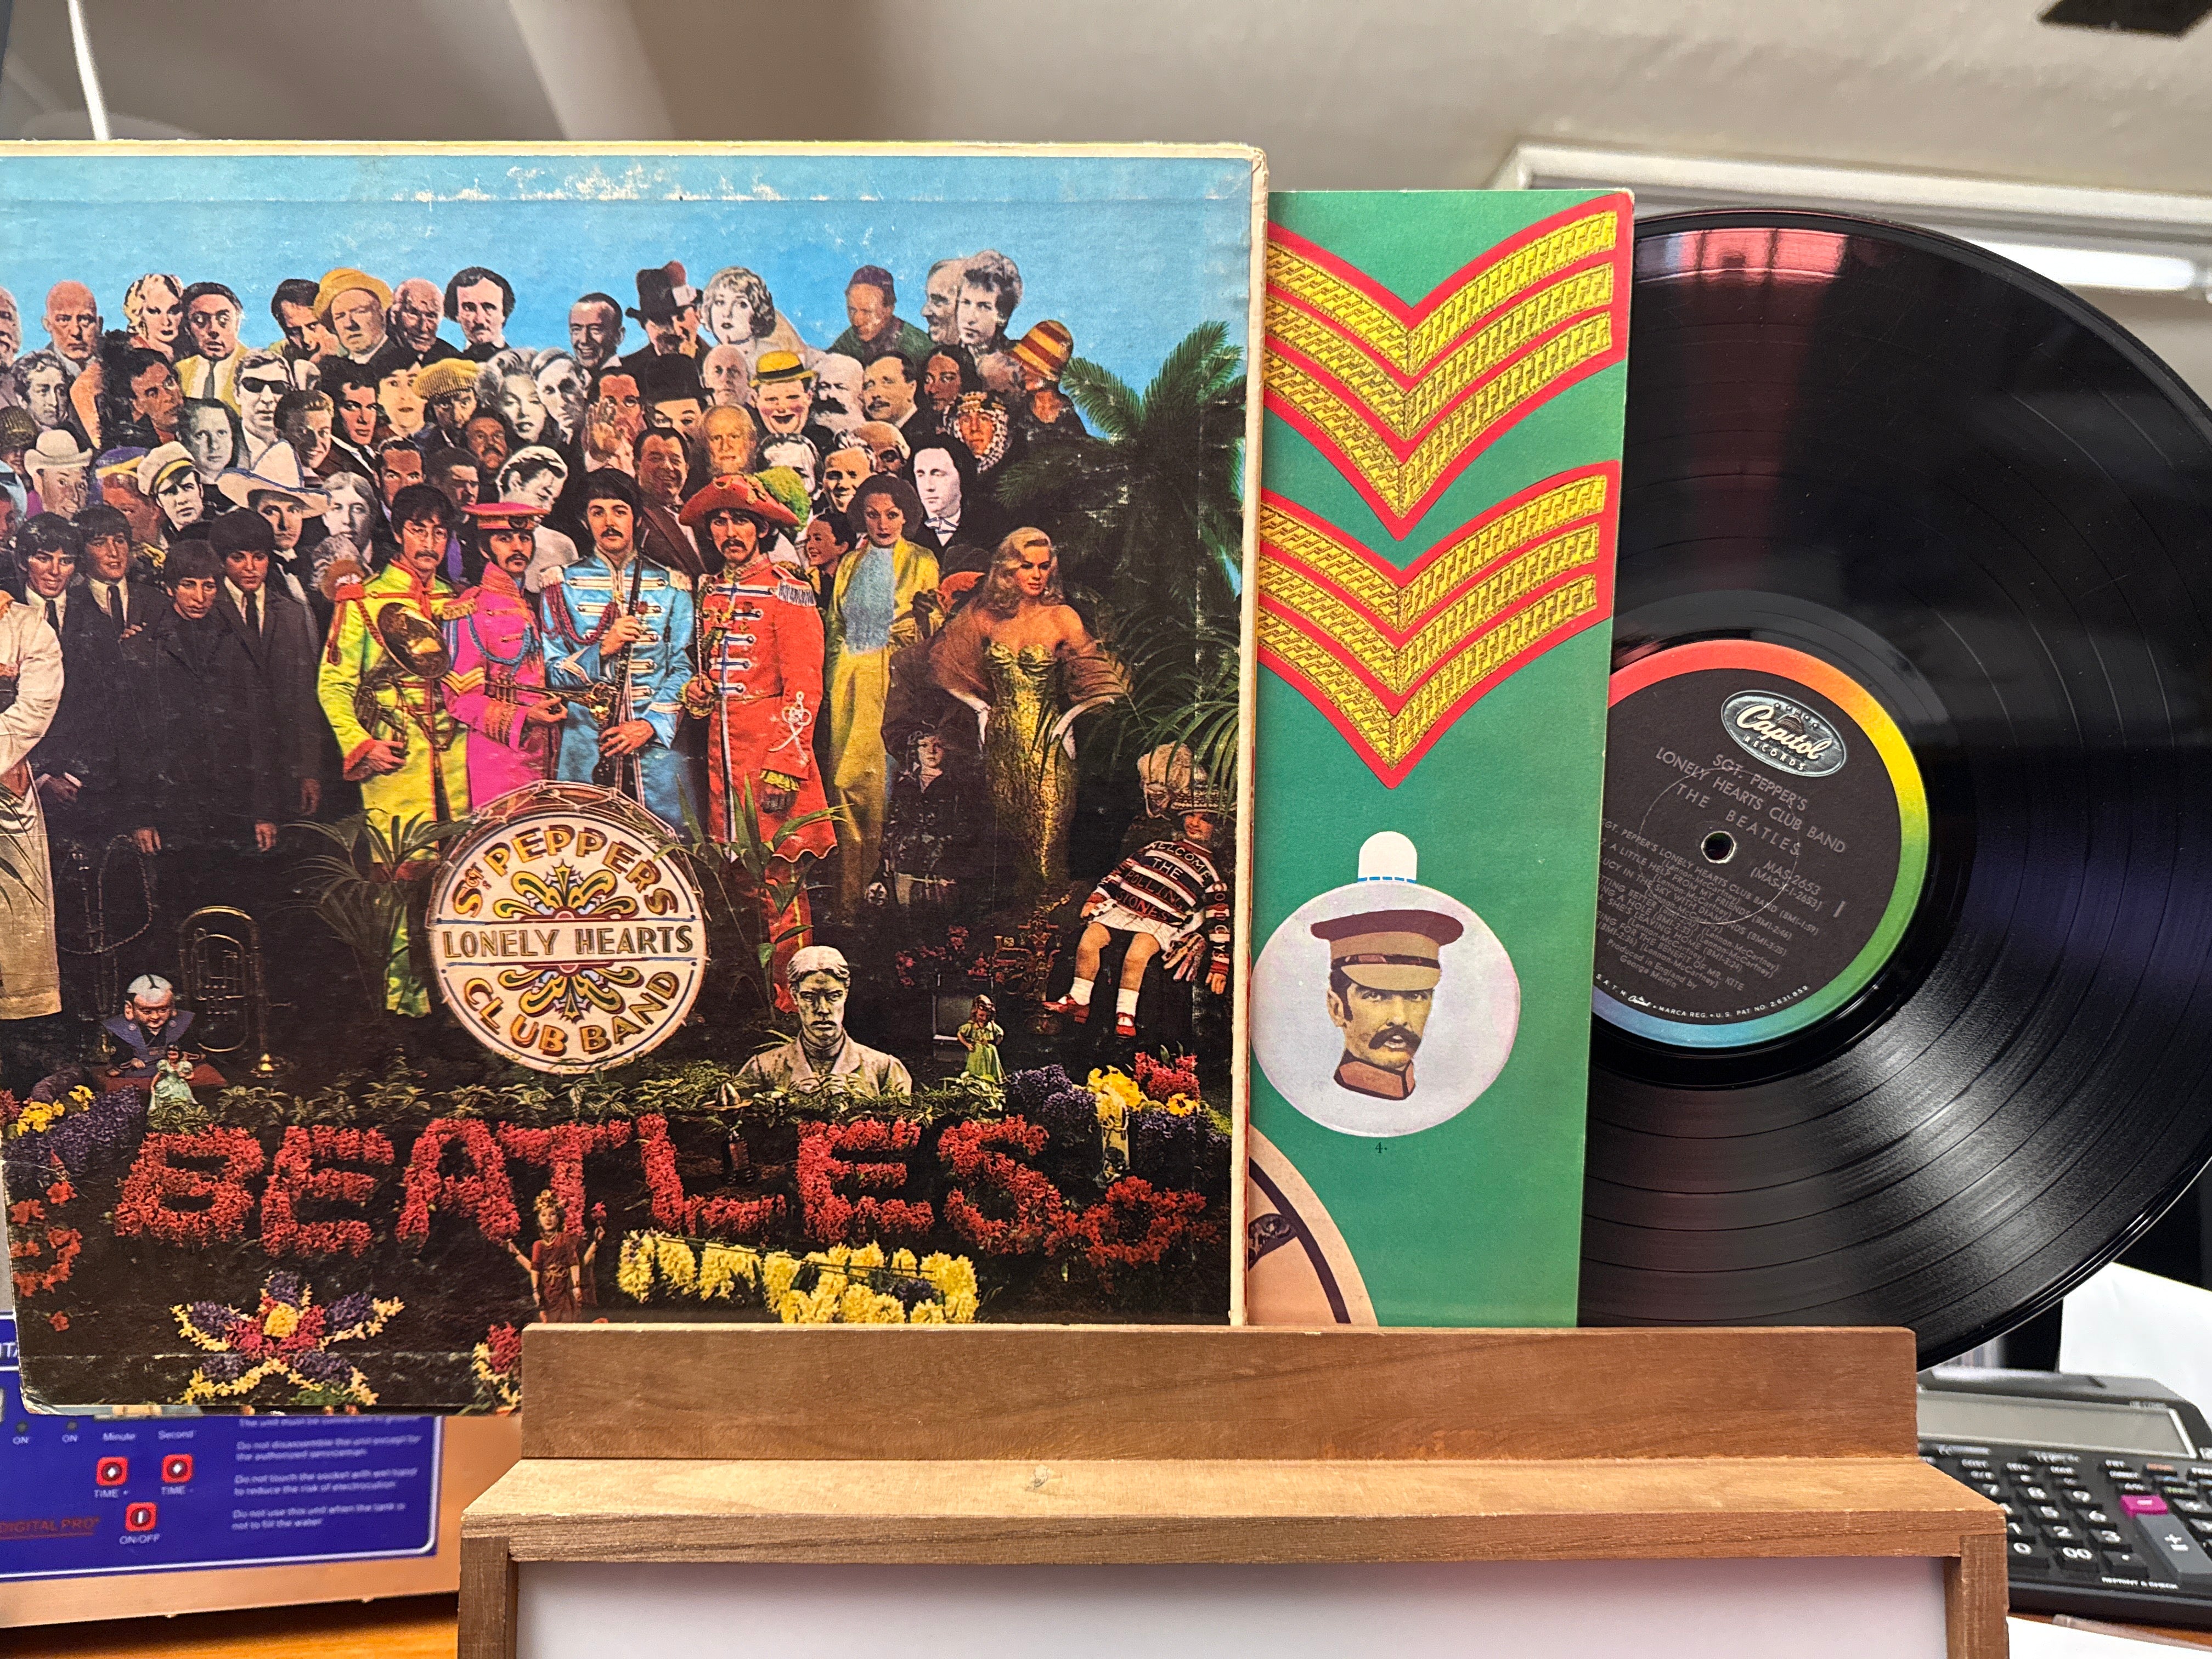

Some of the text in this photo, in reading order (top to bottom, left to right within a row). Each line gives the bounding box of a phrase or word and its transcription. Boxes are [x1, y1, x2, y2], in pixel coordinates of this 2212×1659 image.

[1736, 704, 1832, 760] Capitol
[1743, 736, 1805, 771] RECORDS
[1655, 746, 1847, 855] LONELY HEARTS CLUB BAND
[1711, 752, 1809, 812] SGT. PEPPER'S
[1674, 782, 1802, 856] THE BEATLES
[483, 824, 680, 916] PEPPERS
[1152, 858, 1183, 880] THE
[1609, 842, 1618, 851] A
[1619, 847, 1647, 866] LITTLE
[1647, 861, 1671, 878] HELP
[1671, 873, 1697, 891] FROM
[1699, 888, 1714, 900] MY
[1714, 895, 1751, 919] FRIENDS
[1621, 828, 1658, 853] PEPPER'S
[1658, 848, 1693, 870] LONELY
[1694, 866, 1728, 888] HEARTS
[1728, 883, 1752, 900] CLUB
[1752, 895, 1778, 913] BAND
[1660, 859, 1741, 906] (Lennon-McCartney)
[1115, 891, 1170, 921] STONES
[1598, 855, 1622, 872] UCY
[1622, 867, 1634, 878] IN
[1635, 874, 1654, 889] THE
[1654, 883, 1672, 898] SKY
[1672, 893, 1696, 910] WITH
[1697, 906, 1746, 935] DIAMONDS
[1651, 873, 1733, 920] (Lennon-McCartney)
[443, 926, 693, 958] LONELY HEARTS
[1598, 873, 1627, 894] TTING
[1627, 889, 1657, 909] BETTER
[1700, 926, 1780, 973] (Lennon-McCartney)
[1606, 897, 1633, 916] SHE'S
[1633, 910, 1672, 936] LEAVING
[1673, 931, 1702, 951] HOME
[1617, 893, 1626, 902] A
[1626, 898, 1652, 916] HOLE
[1694, 933, 1774, 980] (Lennon-McCartney)
[1626, 917, 1707, 963] (Lennon-McCartney)
[1595, 909, 1745, 991] EING FOR THE BENEFIT OF MR. KITE
[1606, 938, 1699, 991] Produced in England by
[1618, 953, 1678, 989] George Martin
[1639, 943, 1719, 989] (Lennon-McCartney)
[464, 971, 680, 1057] CLUB BAND
[1658, 1005, 1687, 1017] MARCA
[1375, 1141, 1387, 1154] 4.
[114, 1113, 1062, 1259] BEATLES
[102, 1432, 137, 1442] Minute
[157, 1430, 195, 1440] Second
[94, 1489, 119, 1499] TIME
[161, 1485, 186, 1495] TIME
[2013, 1542, 2093, 1560] 0 00
[2052, 1525, 2073, 1538] 2
[2101, 1530, 2122, 1543] 3
